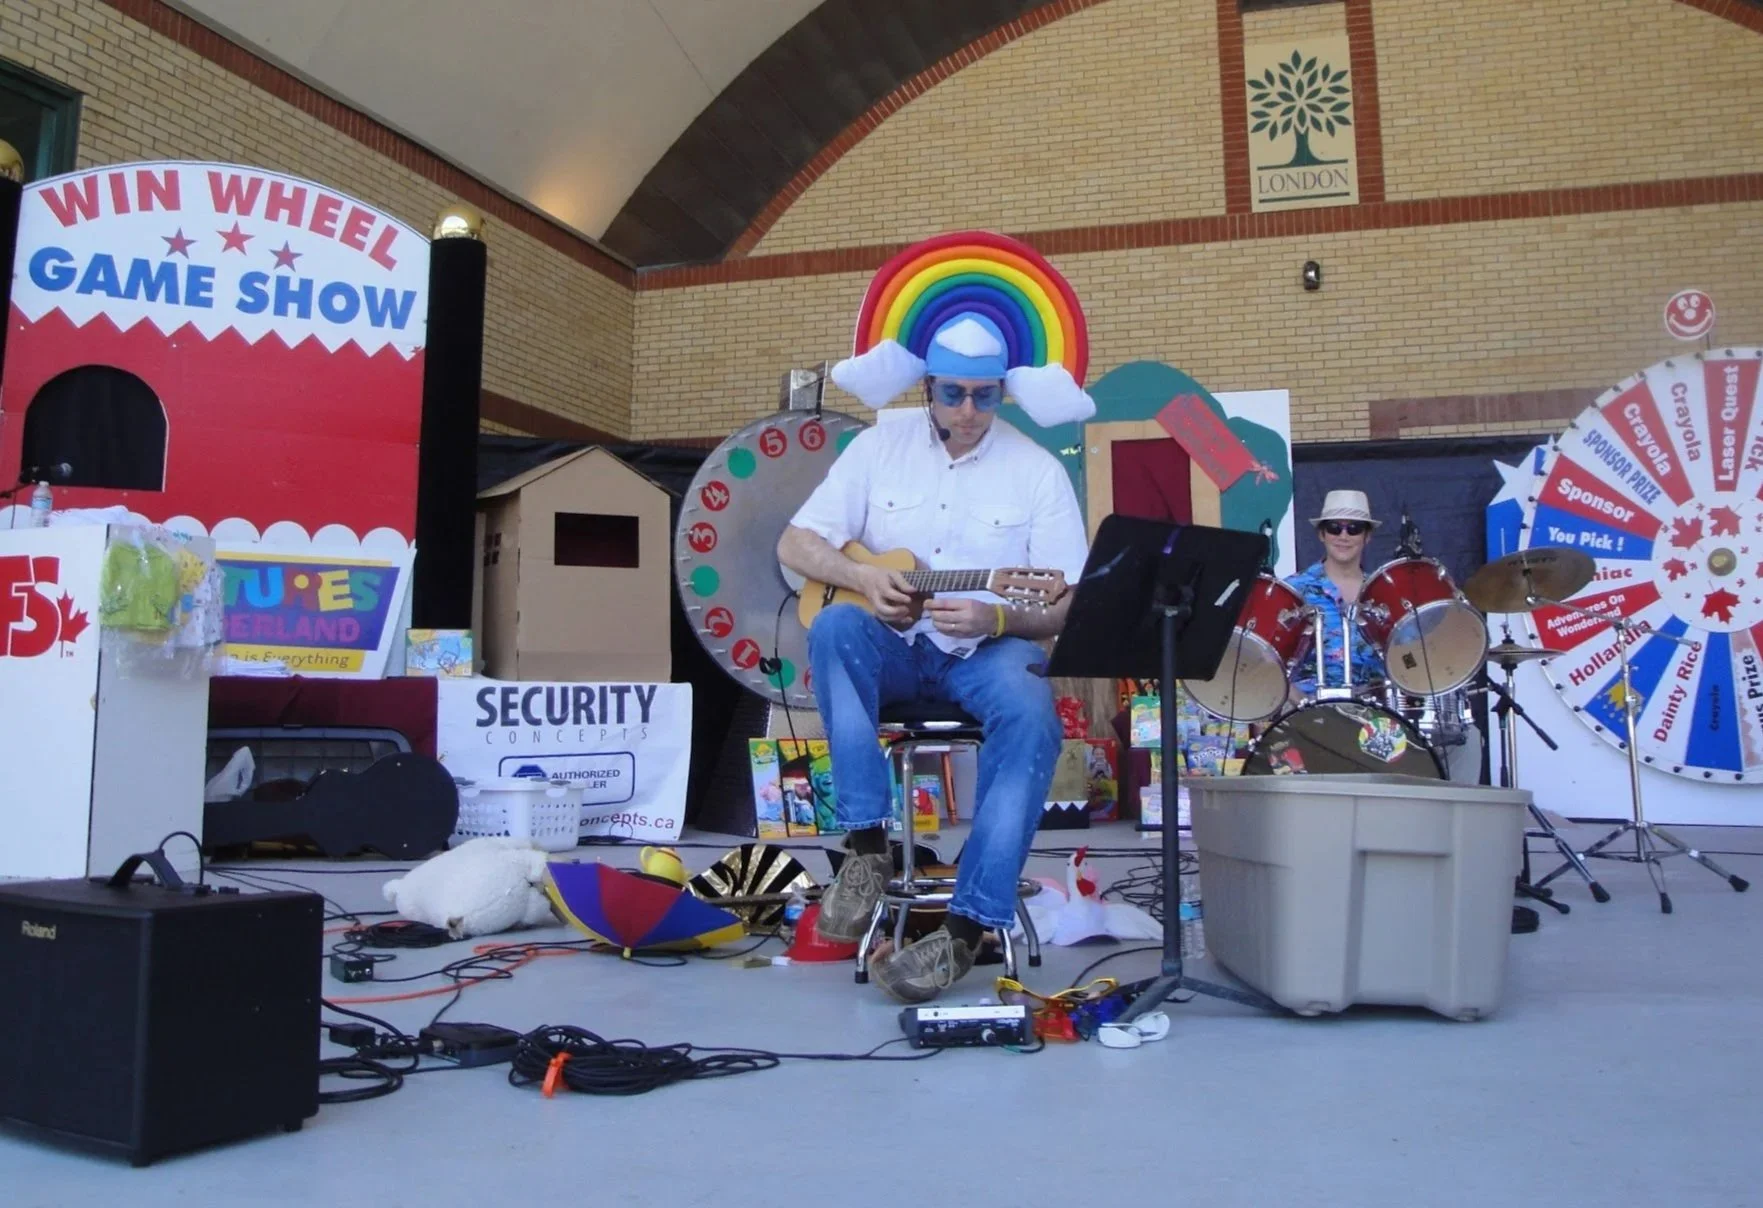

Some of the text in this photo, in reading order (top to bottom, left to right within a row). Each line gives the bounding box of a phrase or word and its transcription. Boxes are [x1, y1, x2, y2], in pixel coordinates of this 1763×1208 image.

[1258, 168, 1349, 194] LONDON
[39, 170, 399, 271] WIN WHEEL
[29, 246, 416, 330] GAME SHOW
[802, 421, 823, 447] 6
[1623, 403, 1671, 476] Crayola
[1671, 382, 1702, 461] Crayola
[1718, 365, 1739, 481] Laser Quest
[765, 431, 783, 456] 5
[1583, 429, 1662, 505] SPONSOR PRIZE
[1557, 478, 1635, 523] Sponsor
[1548, 526, 1575, 545] You
[1579, 532, 1613, 551] Pick
[221, 566, 382, 613] TURES
[1592, 566, 1633, 581] niac
[1608, 593, 1626, 606] On
[228, 612, 361, 644] ERLAND
[1653, 641, 1702, 743] Dainty Rice
[1741, 655, 1763, 699] Prize
[476, 685, 657, 727] SECURITY
[485, 727, 649, 744] CONCEPTS
[551, 769, 621, 781] AUTHORIZED
[579, 811, 675, 829] oncepts.ca
[22, 920, 57, 940] Roland
